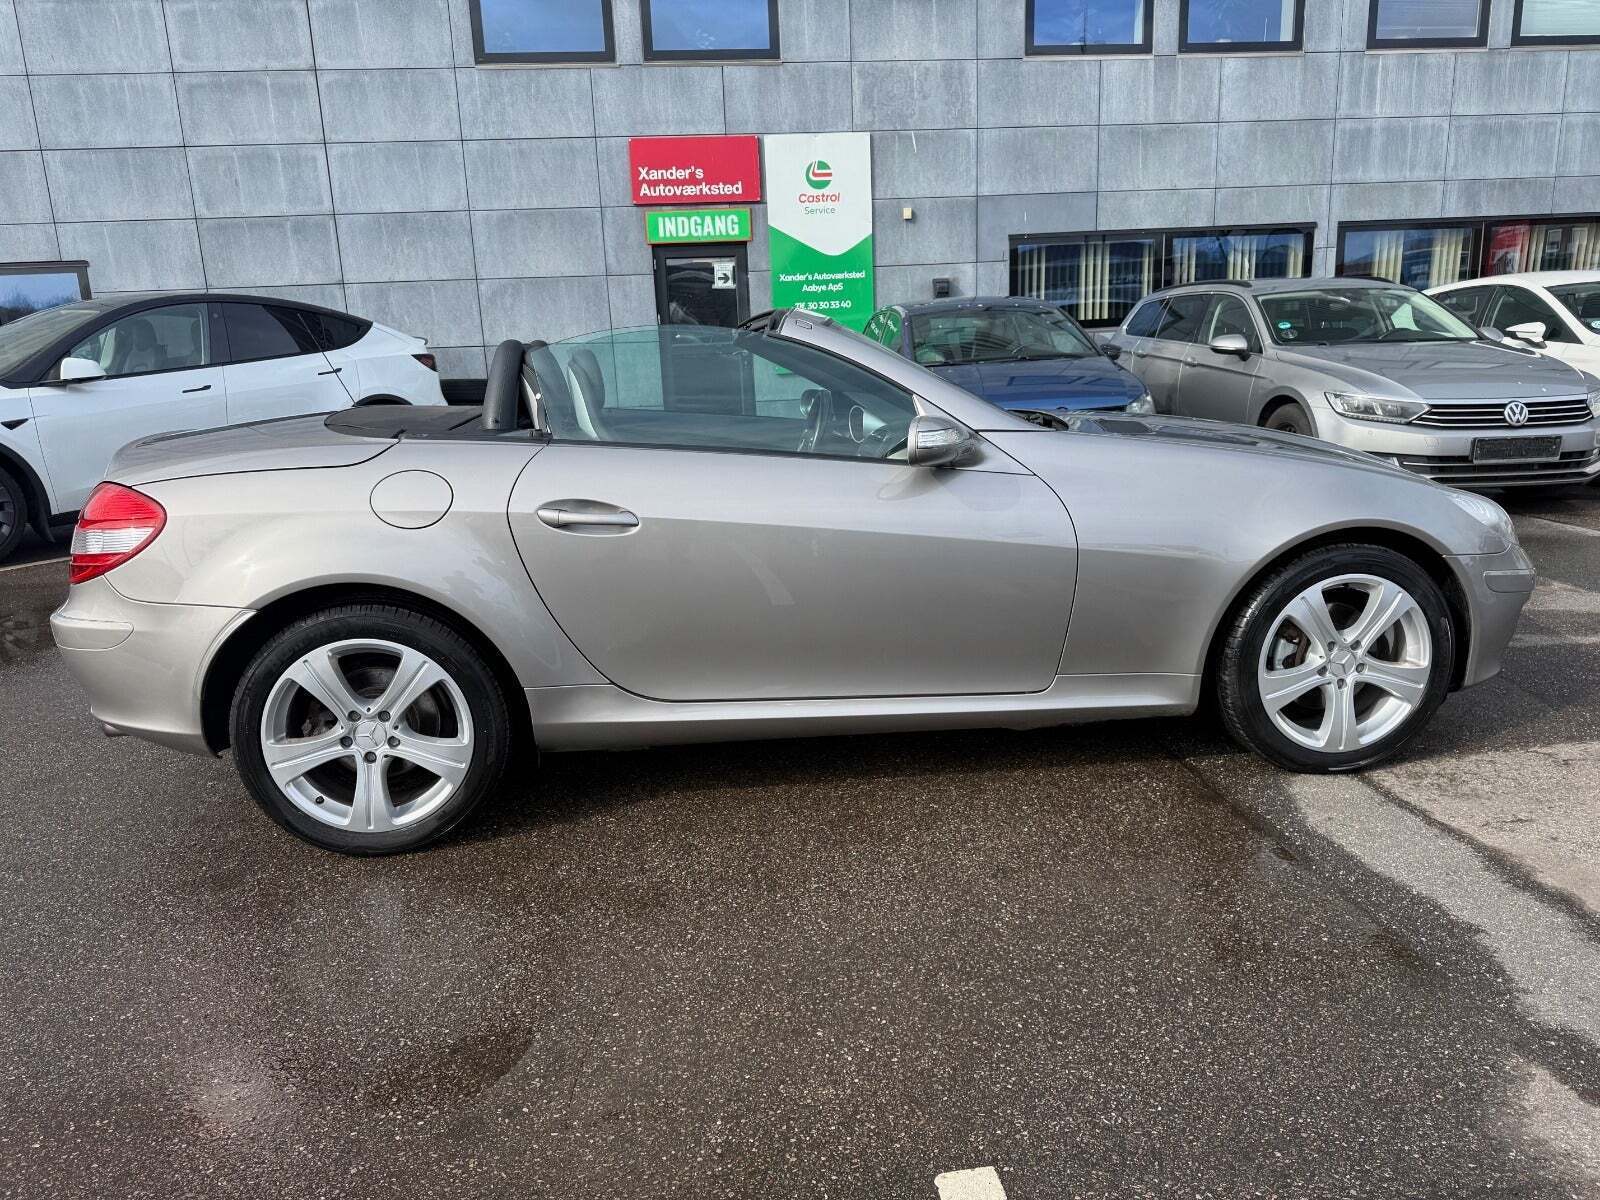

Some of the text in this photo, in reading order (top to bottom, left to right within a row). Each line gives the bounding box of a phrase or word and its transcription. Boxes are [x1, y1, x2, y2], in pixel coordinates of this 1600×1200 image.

[638, 166, 704, 180] Xander's
[640, 181, 743, 196] Autoværksted
[799, 192, 841, 203] Castrol
[804, 206, 836, 215] Service
[658, 214, 739, 237] INDGANG
[779, 272, 812, 281] Xander's
[802, 283, 843, 292] Aabye ApS
[807, 301, 818, 310] 30
[819, 301, 830, 309] 30
[830, 301, 840, 309] 33
[840, 300, 851, 308] 40
